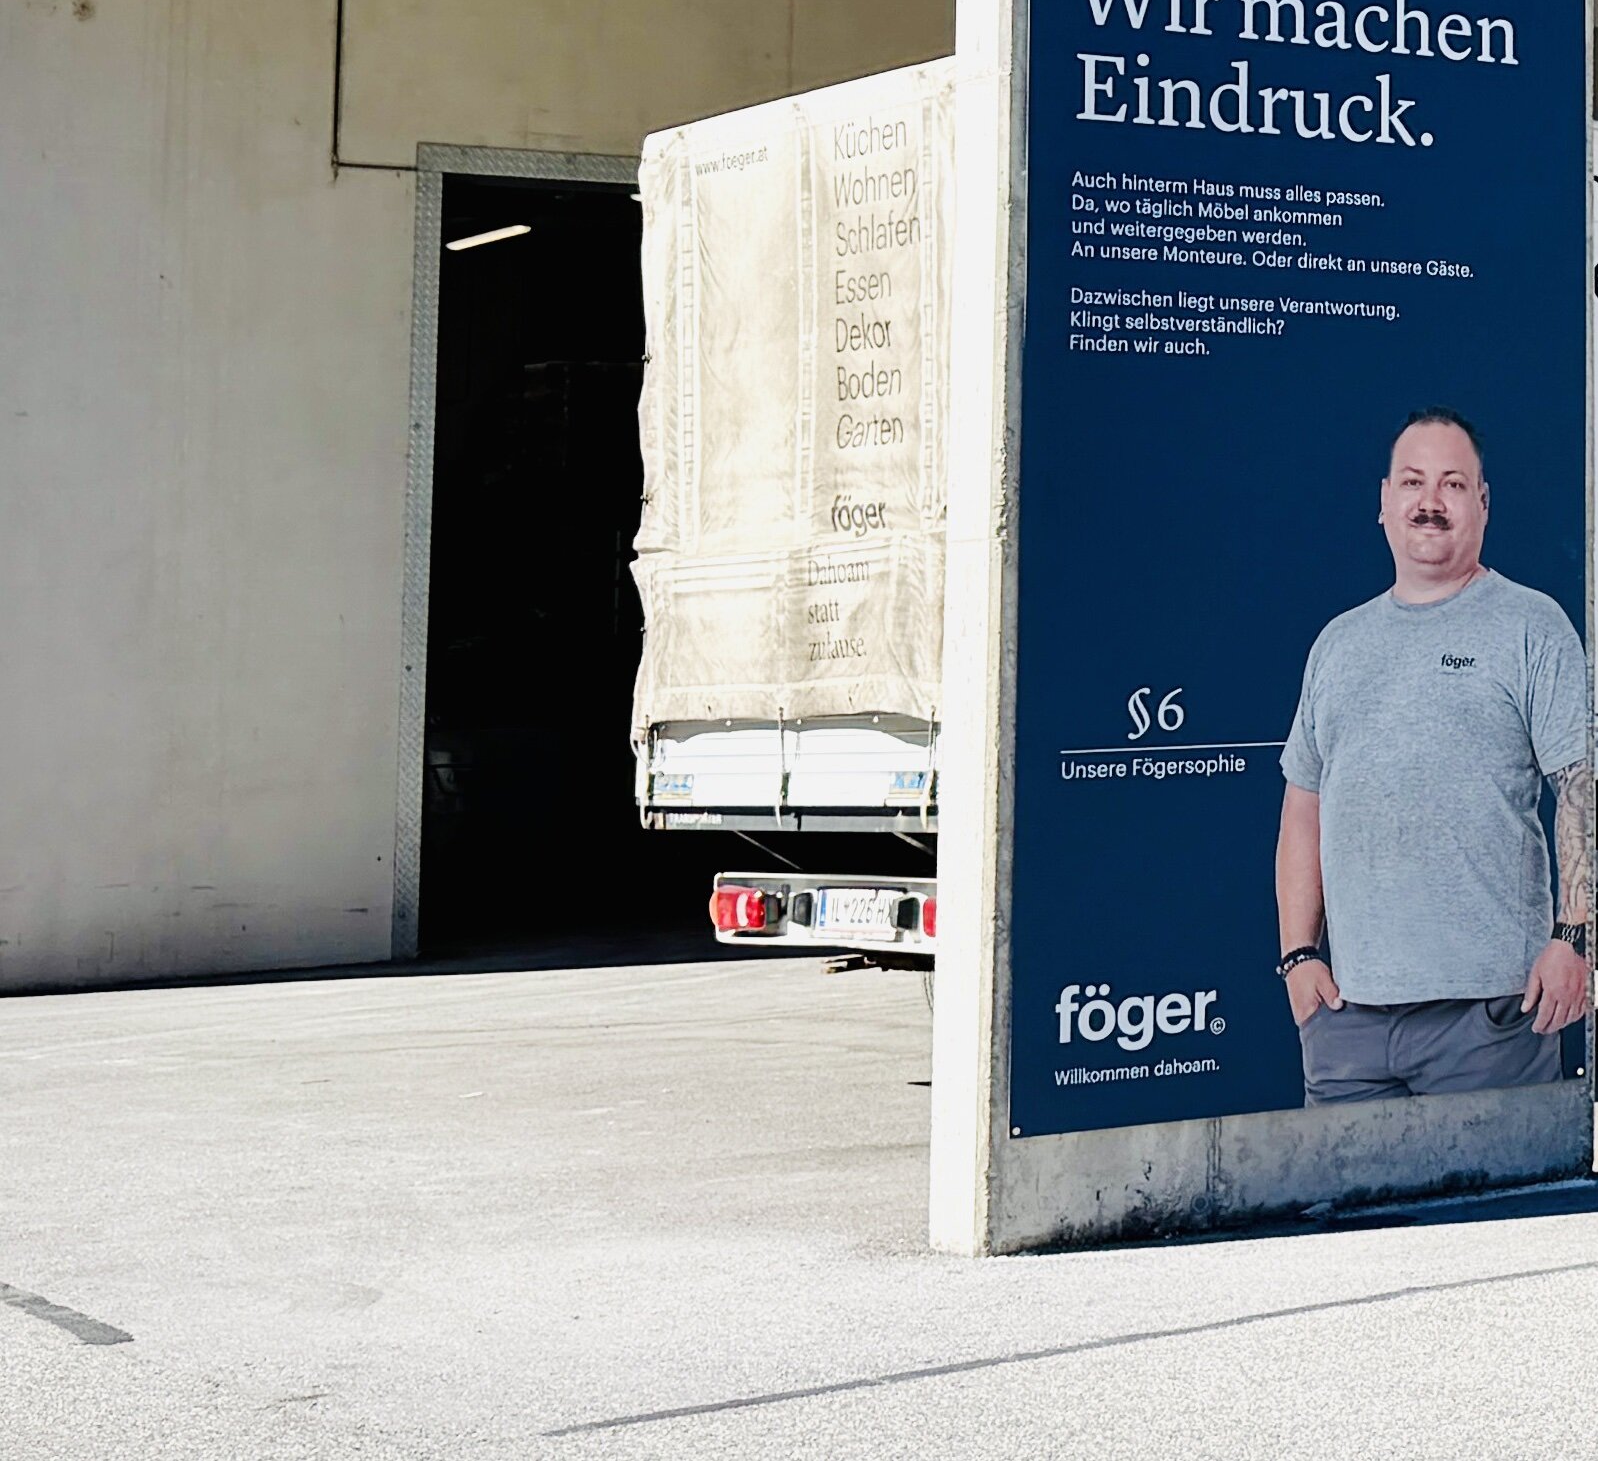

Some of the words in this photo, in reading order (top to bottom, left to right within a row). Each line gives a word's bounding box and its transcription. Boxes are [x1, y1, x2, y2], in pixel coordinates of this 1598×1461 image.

[1076, 52, 1434, 147] Eindruck.
[833, 116, 906, 161] Küchen
[834, 166, 917, 209] Wohnen
[1071, 170, 1118, 190] Auch
[1121, 172, 1188, 194] hinterm
[1193, 178, 1235, 197] Haus
[1239, 184, 1281, 201] muss
[1285, 184, 1321, 203] alles
[1326, 190, 1385, 207] passen.
[1071, 194, 1100, 213] Da,
[1105, 200, 1131, 214] wo
[1135, 197, 1193, 219] täglich
[1198, 201, 1250, 220] Möbel
[1253, 205, 1343, 227] ankommen
[835, 213, 922, 258] Schlafen
[1071, 218, 1105, 235] und
[1110, 220, 1238, 244] weitergegeben
[1241, 228, 1307, 247] werden.
[1071, 240, 1095, 258] An
[1100, 244, 1159, 261] unsere
[1163, 245, 1248, 266] Monteure.
[1252, 249, 1293, 268] Oder
[1297, 251, 1344, 271] direkt
[1346, 258, 1366, 272] an
[1370, 259, 1423, 276] unsere
[1426, 259, 1475, 279] Gäste.
[835, 269, 892, 306] Essen
[1070, 287, 1173, 309] Dazwischen
[1178, 290, 1216, 313] liegt
[1219, 295, 1276, 313] unsere
[1279, 296, 1400, 320] Verantwortung.
[835, 312, 893, 354] Dekor
[1070, 310, 1121, 333] Klingt
[1124, 313, 1286, 336] selbstverständlich?
[1069, 334, 1129, 352] Finden
[1133, 337, 1160, 354] wir
[1164, 338, 1211, 356] auch.
[836, 360, 902, 404] Boden
[836, 411, 904, 451] Garten
[831, 493, 888, 538] föger
[807, 598, 841, 624] statt
[1061, 760, 1127, 780] Unsere
[1132, 753, 1246, 780] Fögersophie
[1054, 1063, 1149, 1086] Willkommen
[1154, 1055, 1220, 1077] dahoam.
